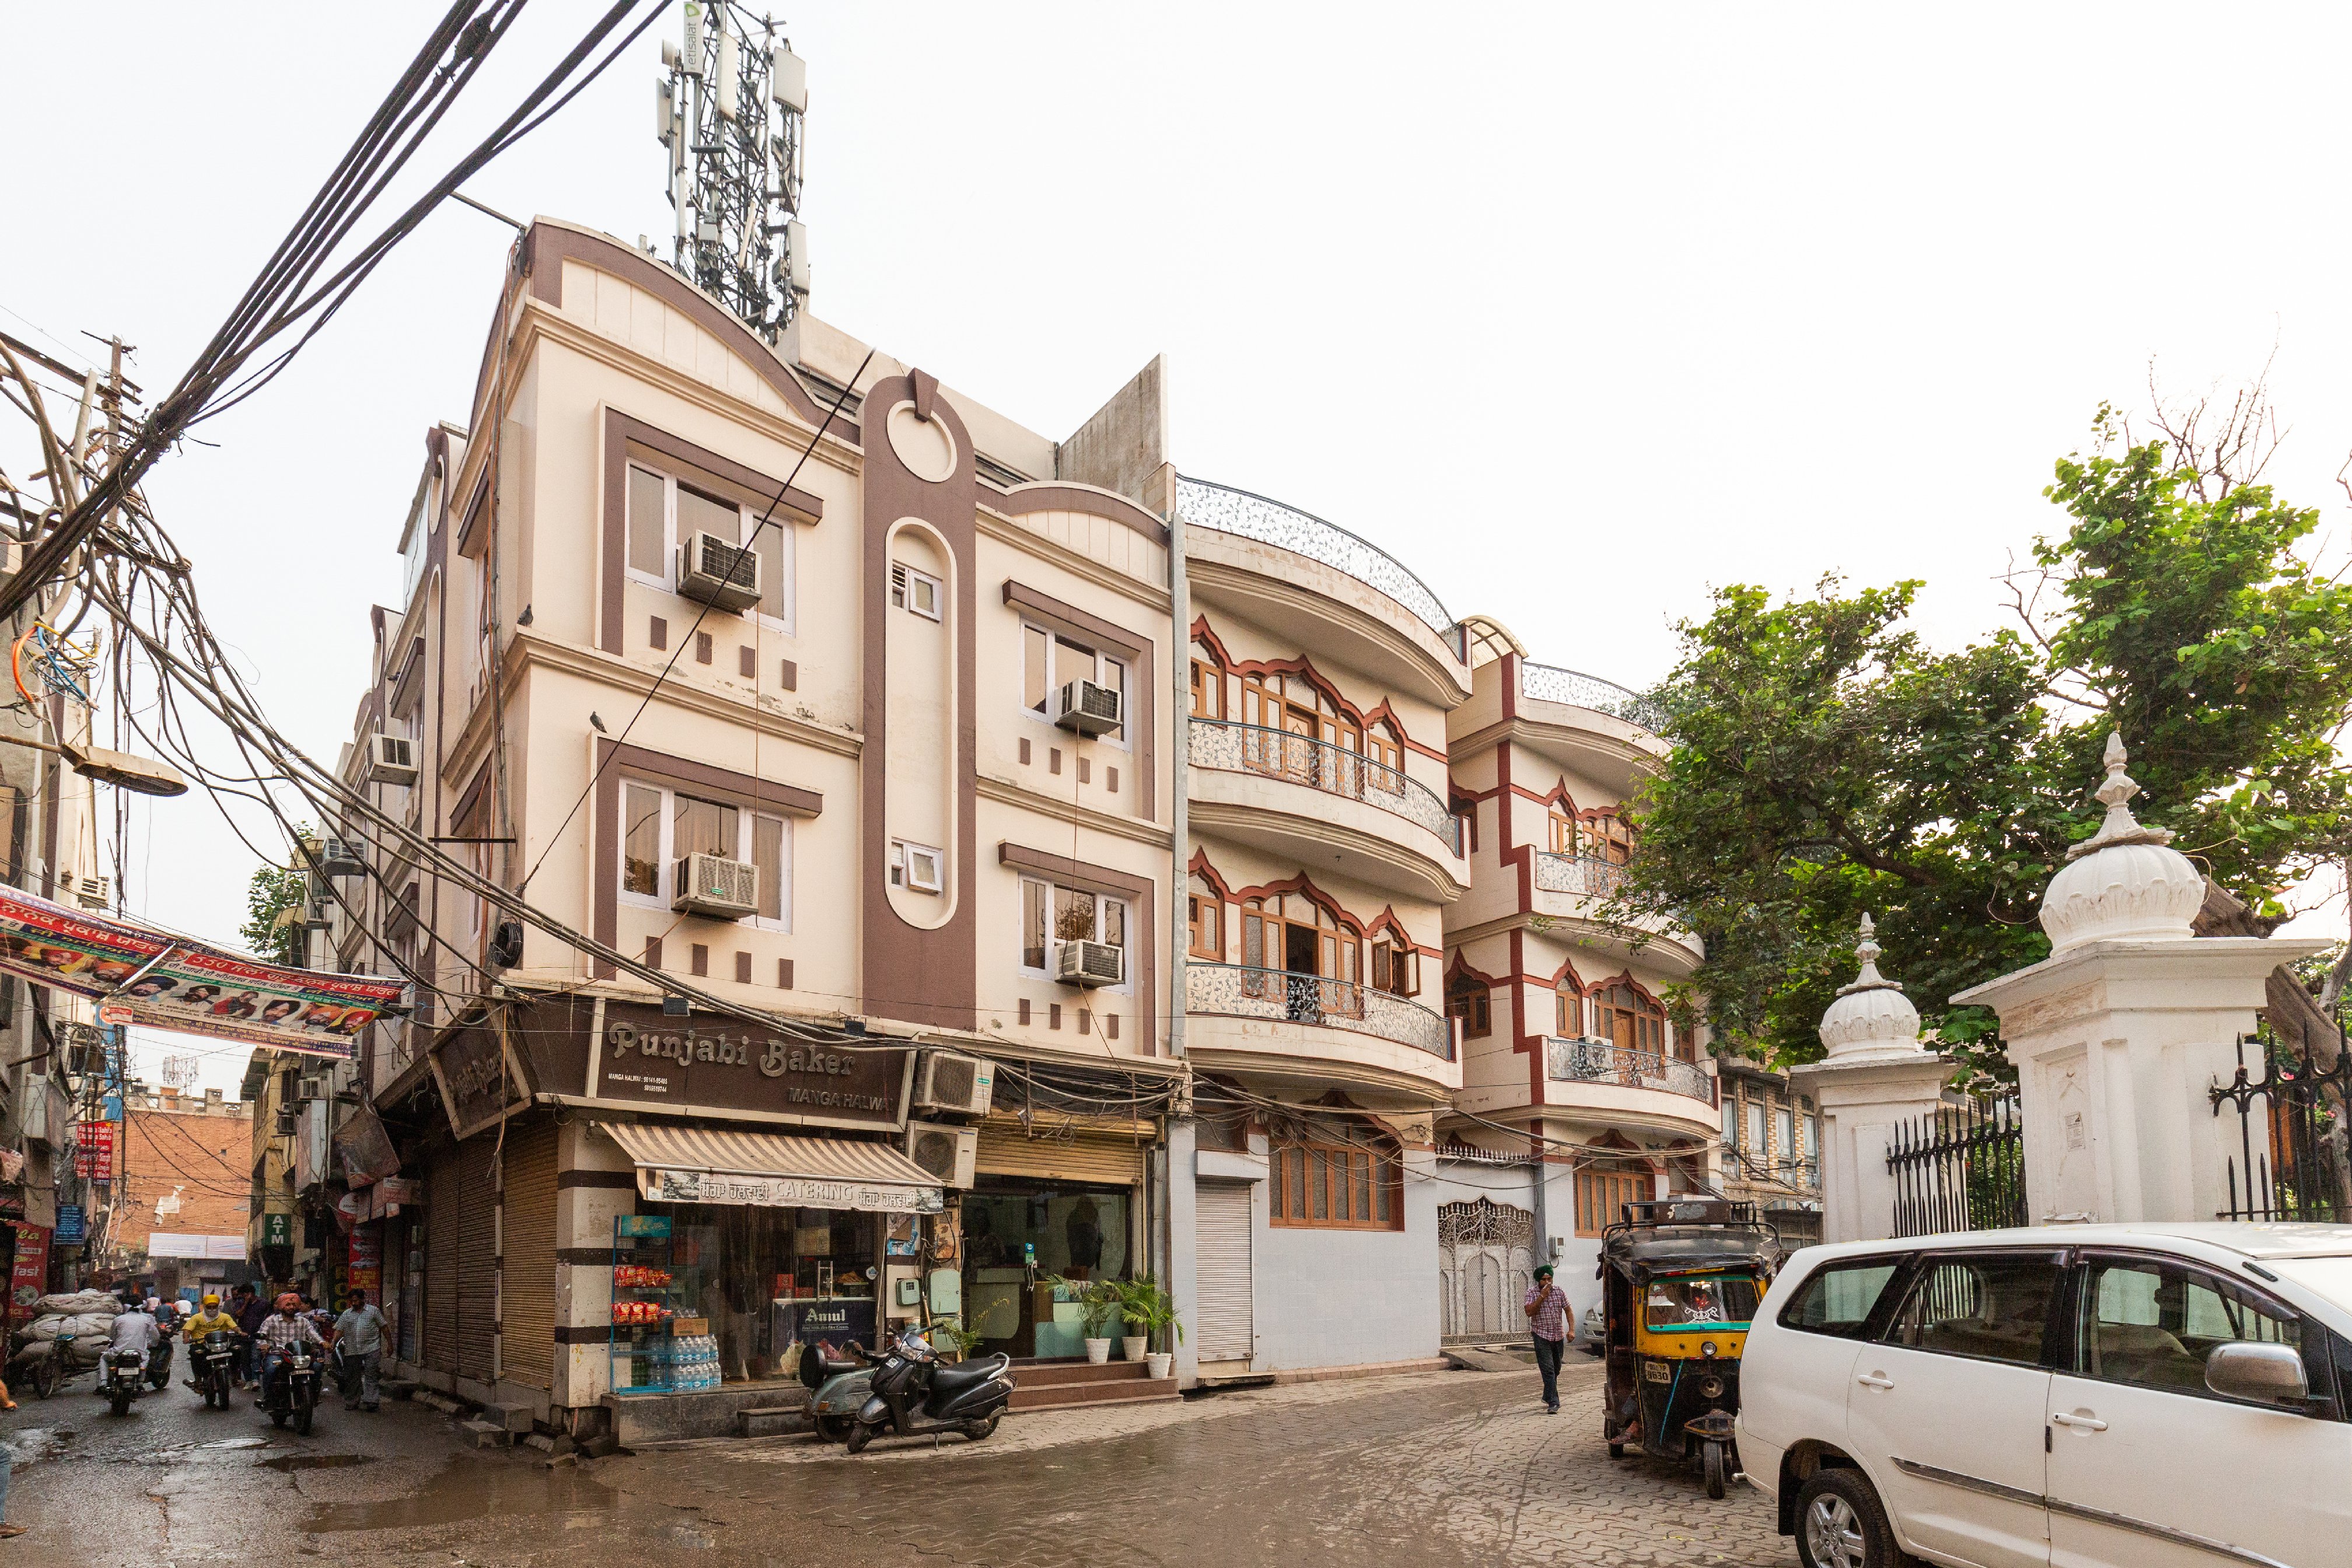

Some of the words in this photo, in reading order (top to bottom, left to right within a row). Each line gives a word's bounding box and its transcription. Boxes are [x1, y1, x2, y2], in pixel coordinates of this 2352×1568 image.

[687, 22, 696, 65] etisalat
[193, 956, 228, 969] 550
[609, 1022, 747, 1066] Punjabi
[760, 1040, 855, 1077] Baker
[624, 1074, 641, 1082] HALWAI
[788, 1087, 840, 1106] MANGA
[700, 1178, 726, 1198] ਮੰਗਾ
[729, 1182, 770, 1200] ਹਲਵਾਈ
[777, 1181, 853, 1200] CATERING
[858, 1188, 880, 1206] ਮੰਗਾ
[882, 1191, 916, 1208] ਹਲਵਾਈ
[271, 1215, 284, 1244] ATM
[14, 1265, 39, 1277] fast
[805, 1308, 845, 1323] Amul
